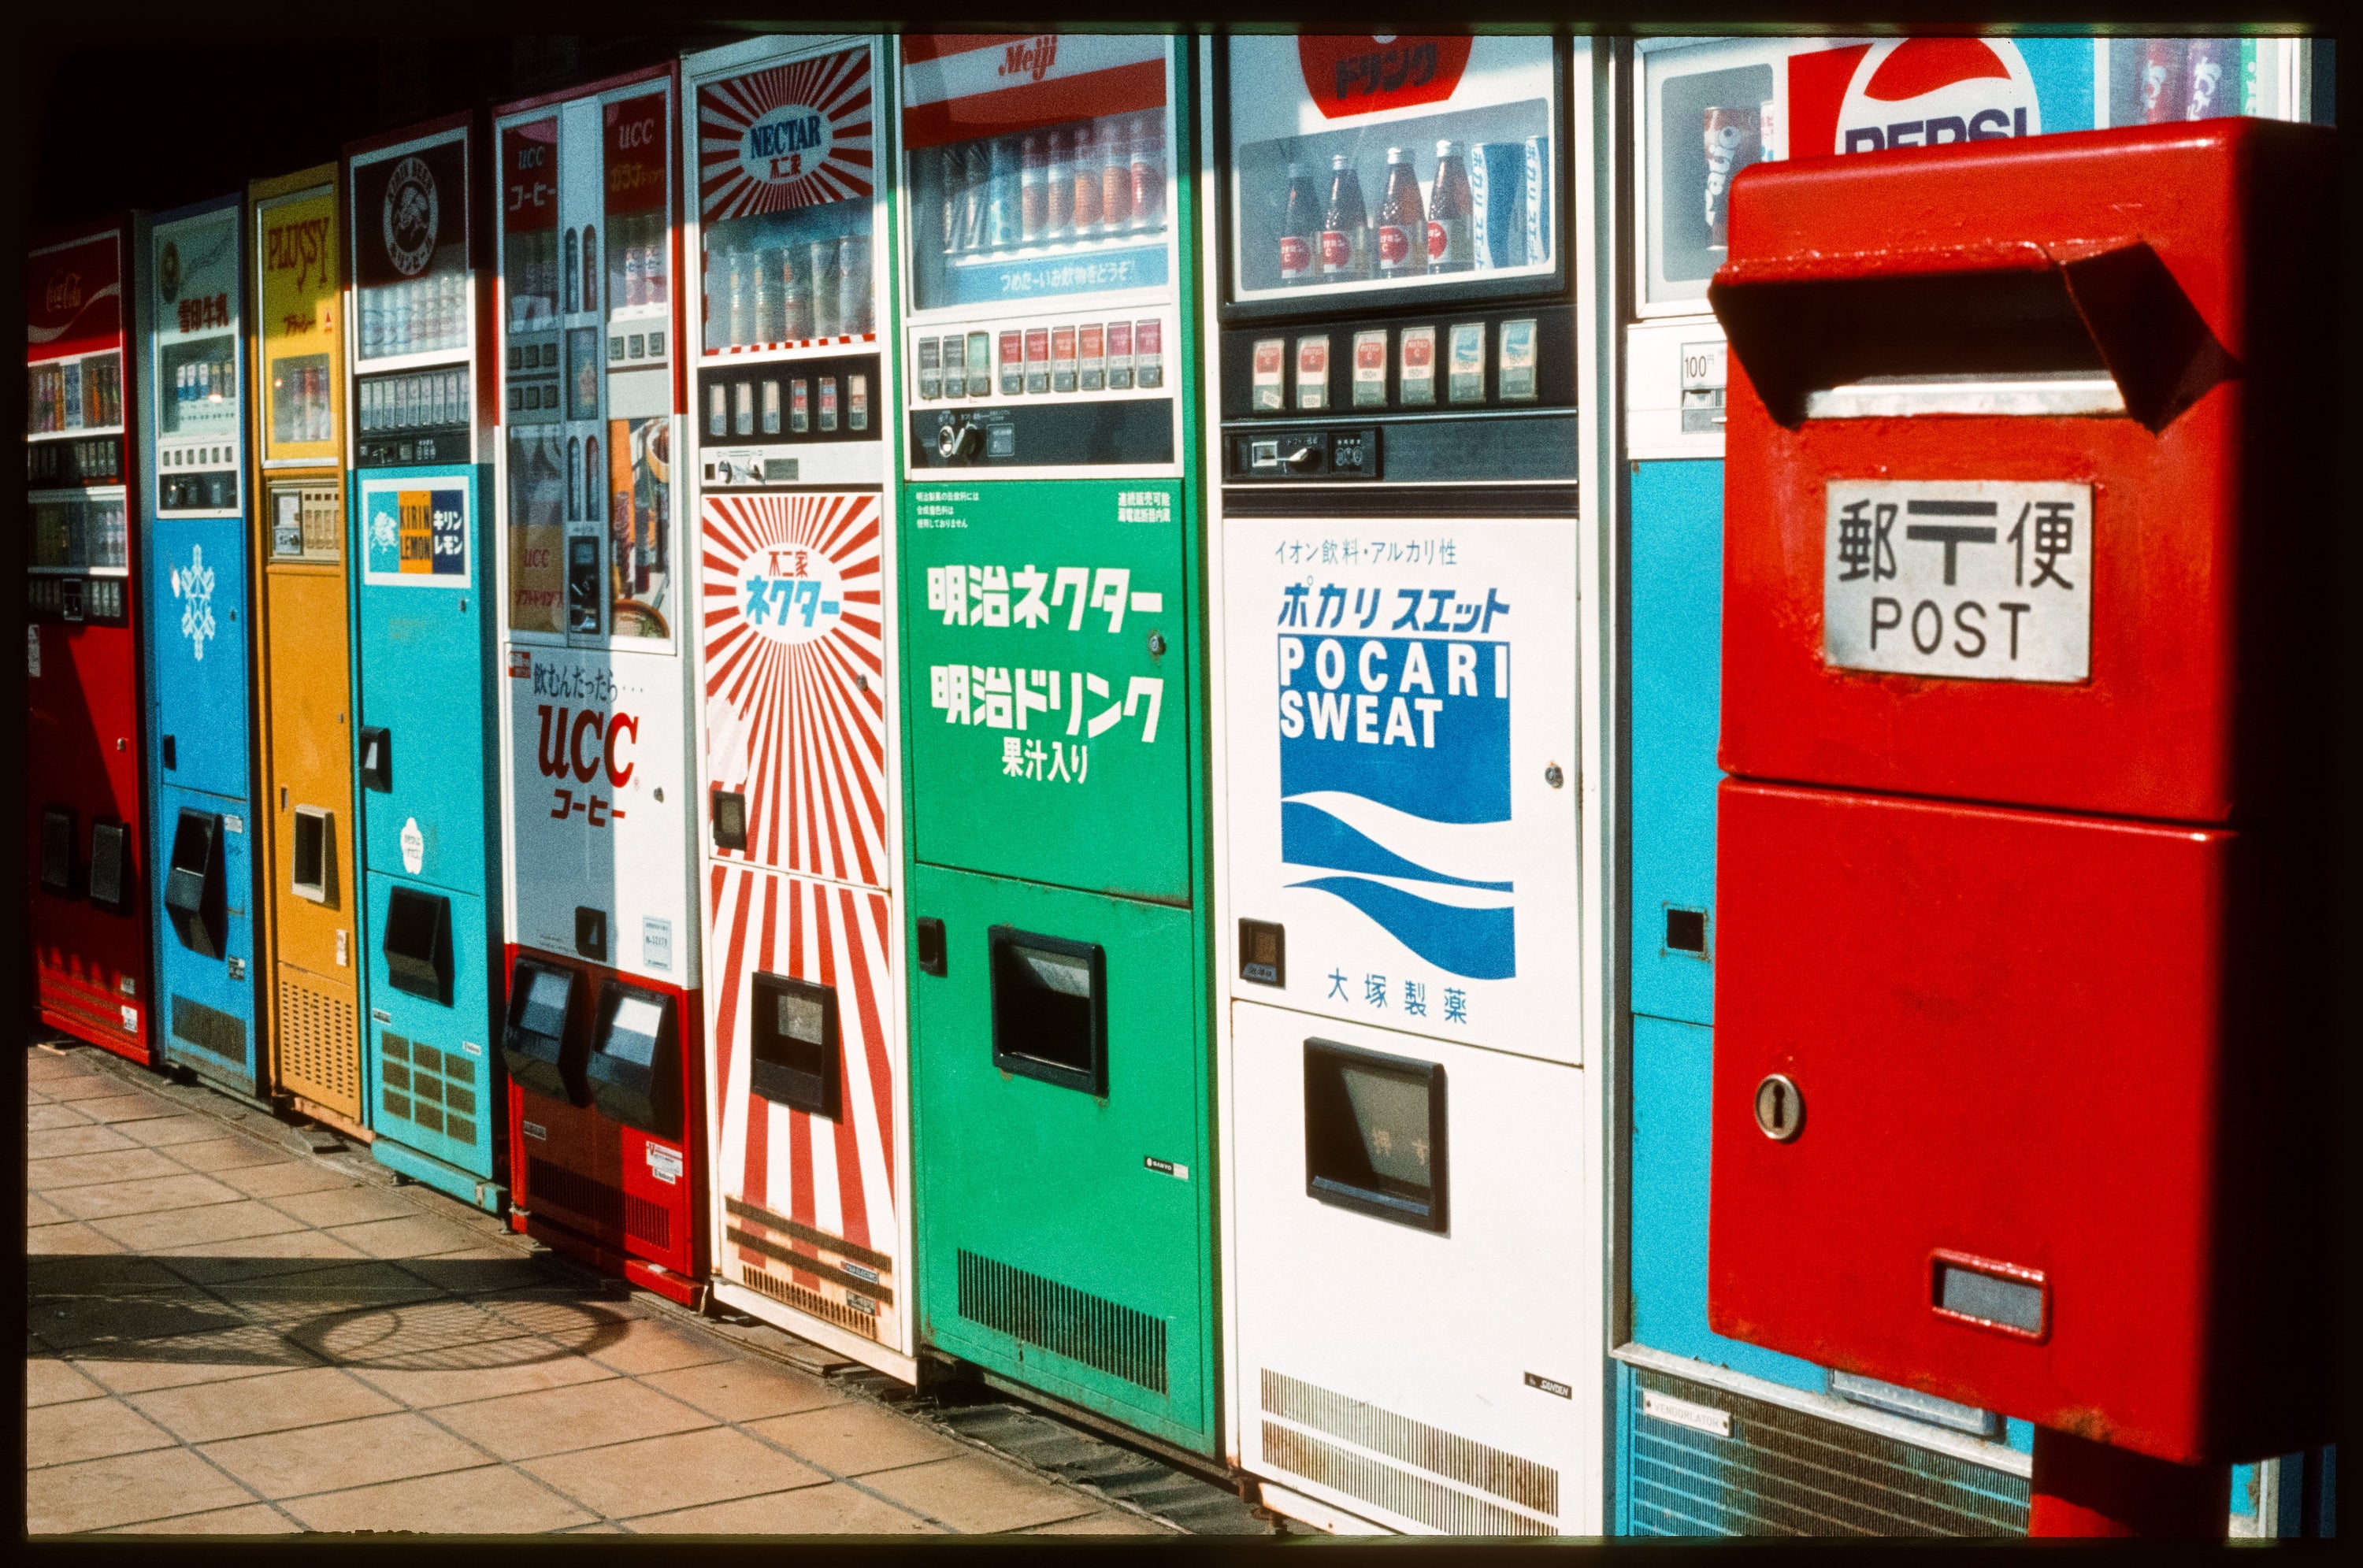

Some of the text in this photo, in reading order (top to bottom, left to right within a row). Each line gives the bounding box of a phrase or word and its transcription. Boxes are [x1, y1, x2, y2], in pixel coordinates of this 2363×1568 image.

[998, 35, 1056, 80] Meiji
[1337, 43, 1437, 100] ドリンク
[749, 115, 822, 160] NECTAR
[509, 182, 557, 211] コーヒー
[268, 217, 329, 295] PLUSSY
[399, 505, 432, 530] KIRIN
[433, 510, 463, 531] キリン
[400, 536, 432, 560] LEMON
[434, 535, 464, 555] レモン
[768, 549, 808, 578] 不二家
[746, 574, 840, 628] ネクター
[927, 564, 1163, 634] 明治ネクター
[1869, 597, 2032, 662] POST
[1279, 636, 1509, 699] POCARI
[930, 664, 1165, 743] 明治ドリンク
[1279, 690, 1444, 749] SWEAT
[538, 704, 640, 788] UCC
[1002, 736, 1089, 784] 果汁入り
[550, 788, 626, 828] コーヒー
[1327, 967, 1468, 1025] 大塚製薬
[1152, 1160, 1172, 1171] SANYO
[1540, 1379, 1569, 1396] SANDEN
[1653, 1403, 1719, 1429] VENDORLATOR
